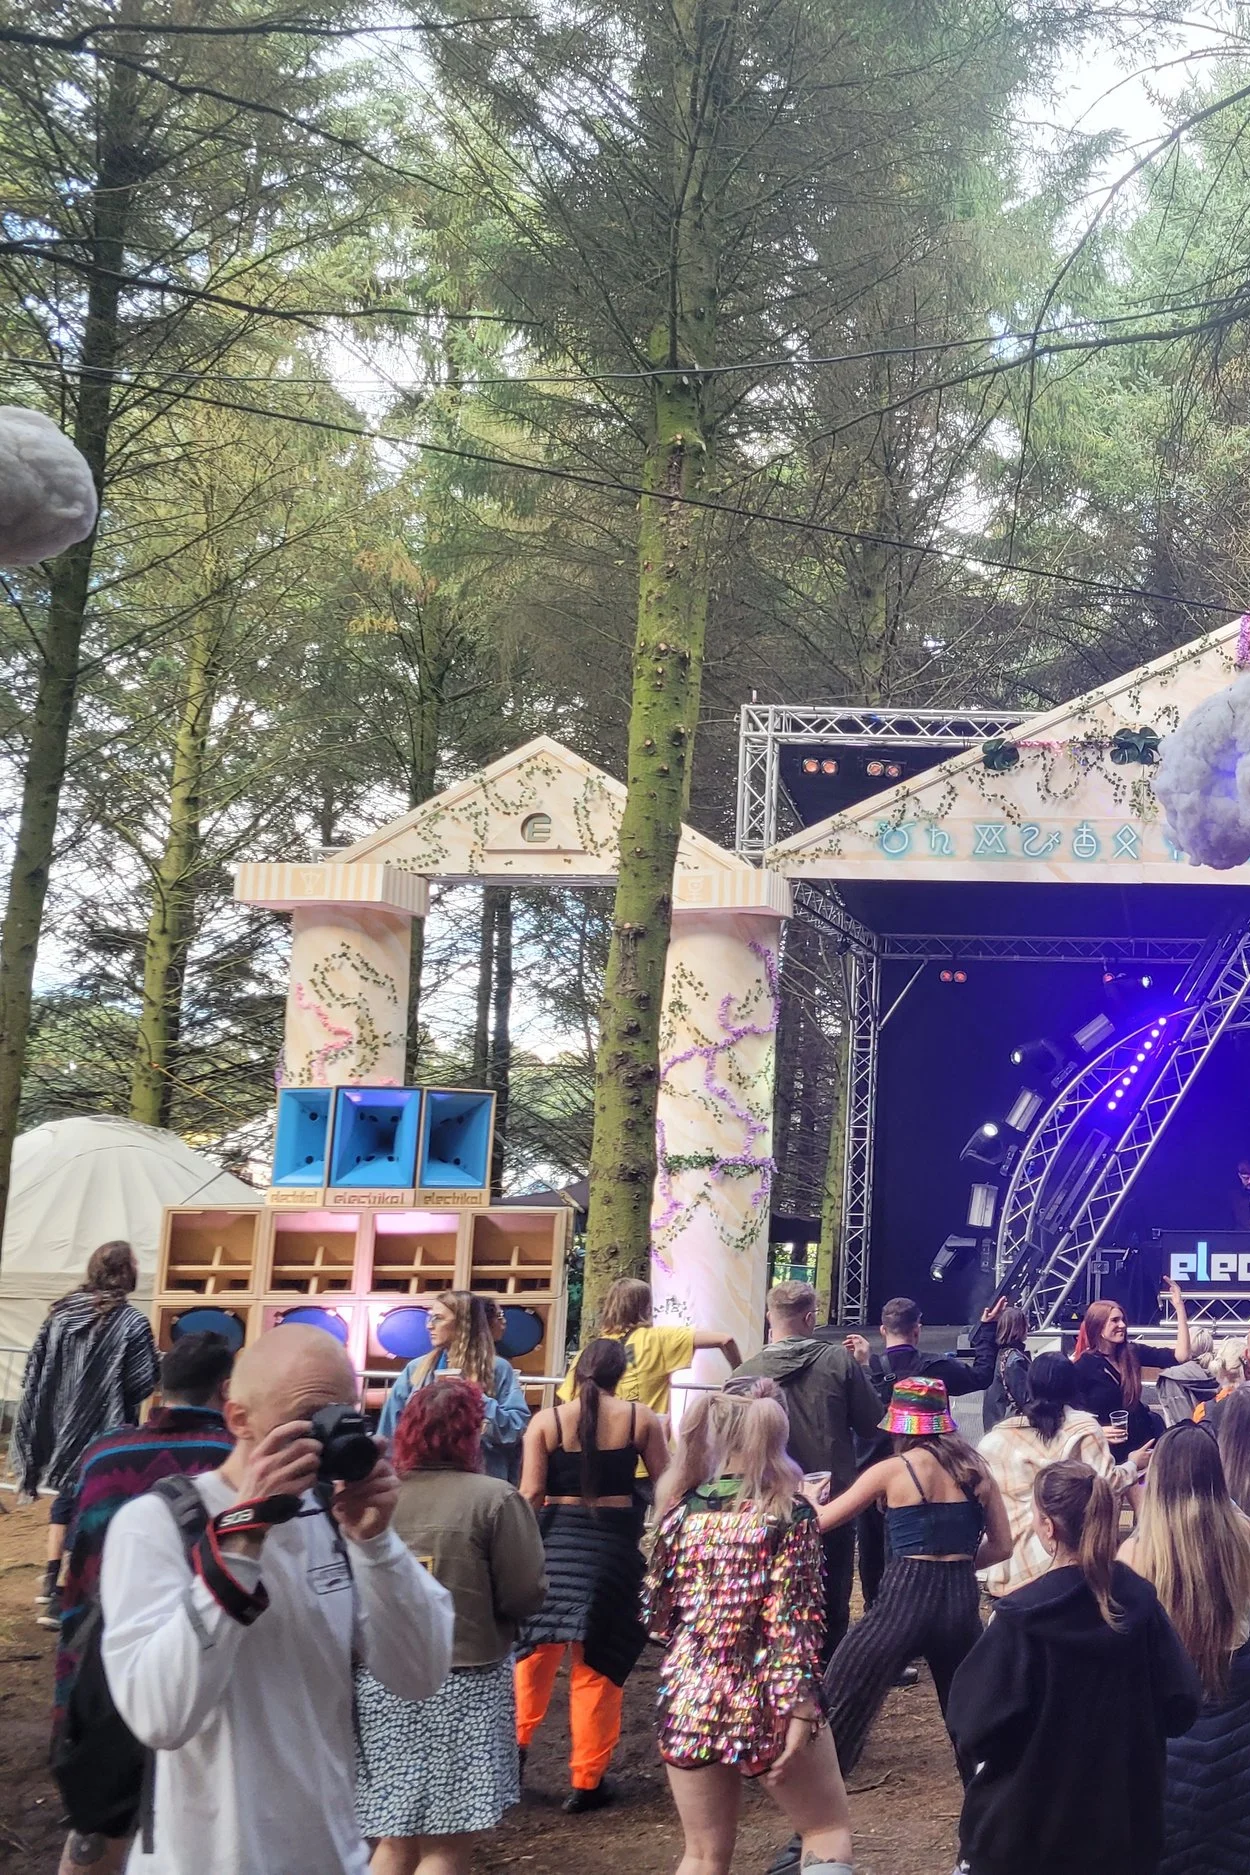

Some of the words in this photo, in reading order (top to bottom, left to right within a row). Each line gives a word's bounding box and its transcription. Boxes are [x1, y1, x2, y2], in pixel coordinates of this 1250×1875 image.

[522, 813, 552, 843] E
[334, 1191, 404, 1205] electrikal
[423, 1191, 483, 1205] electrikal
